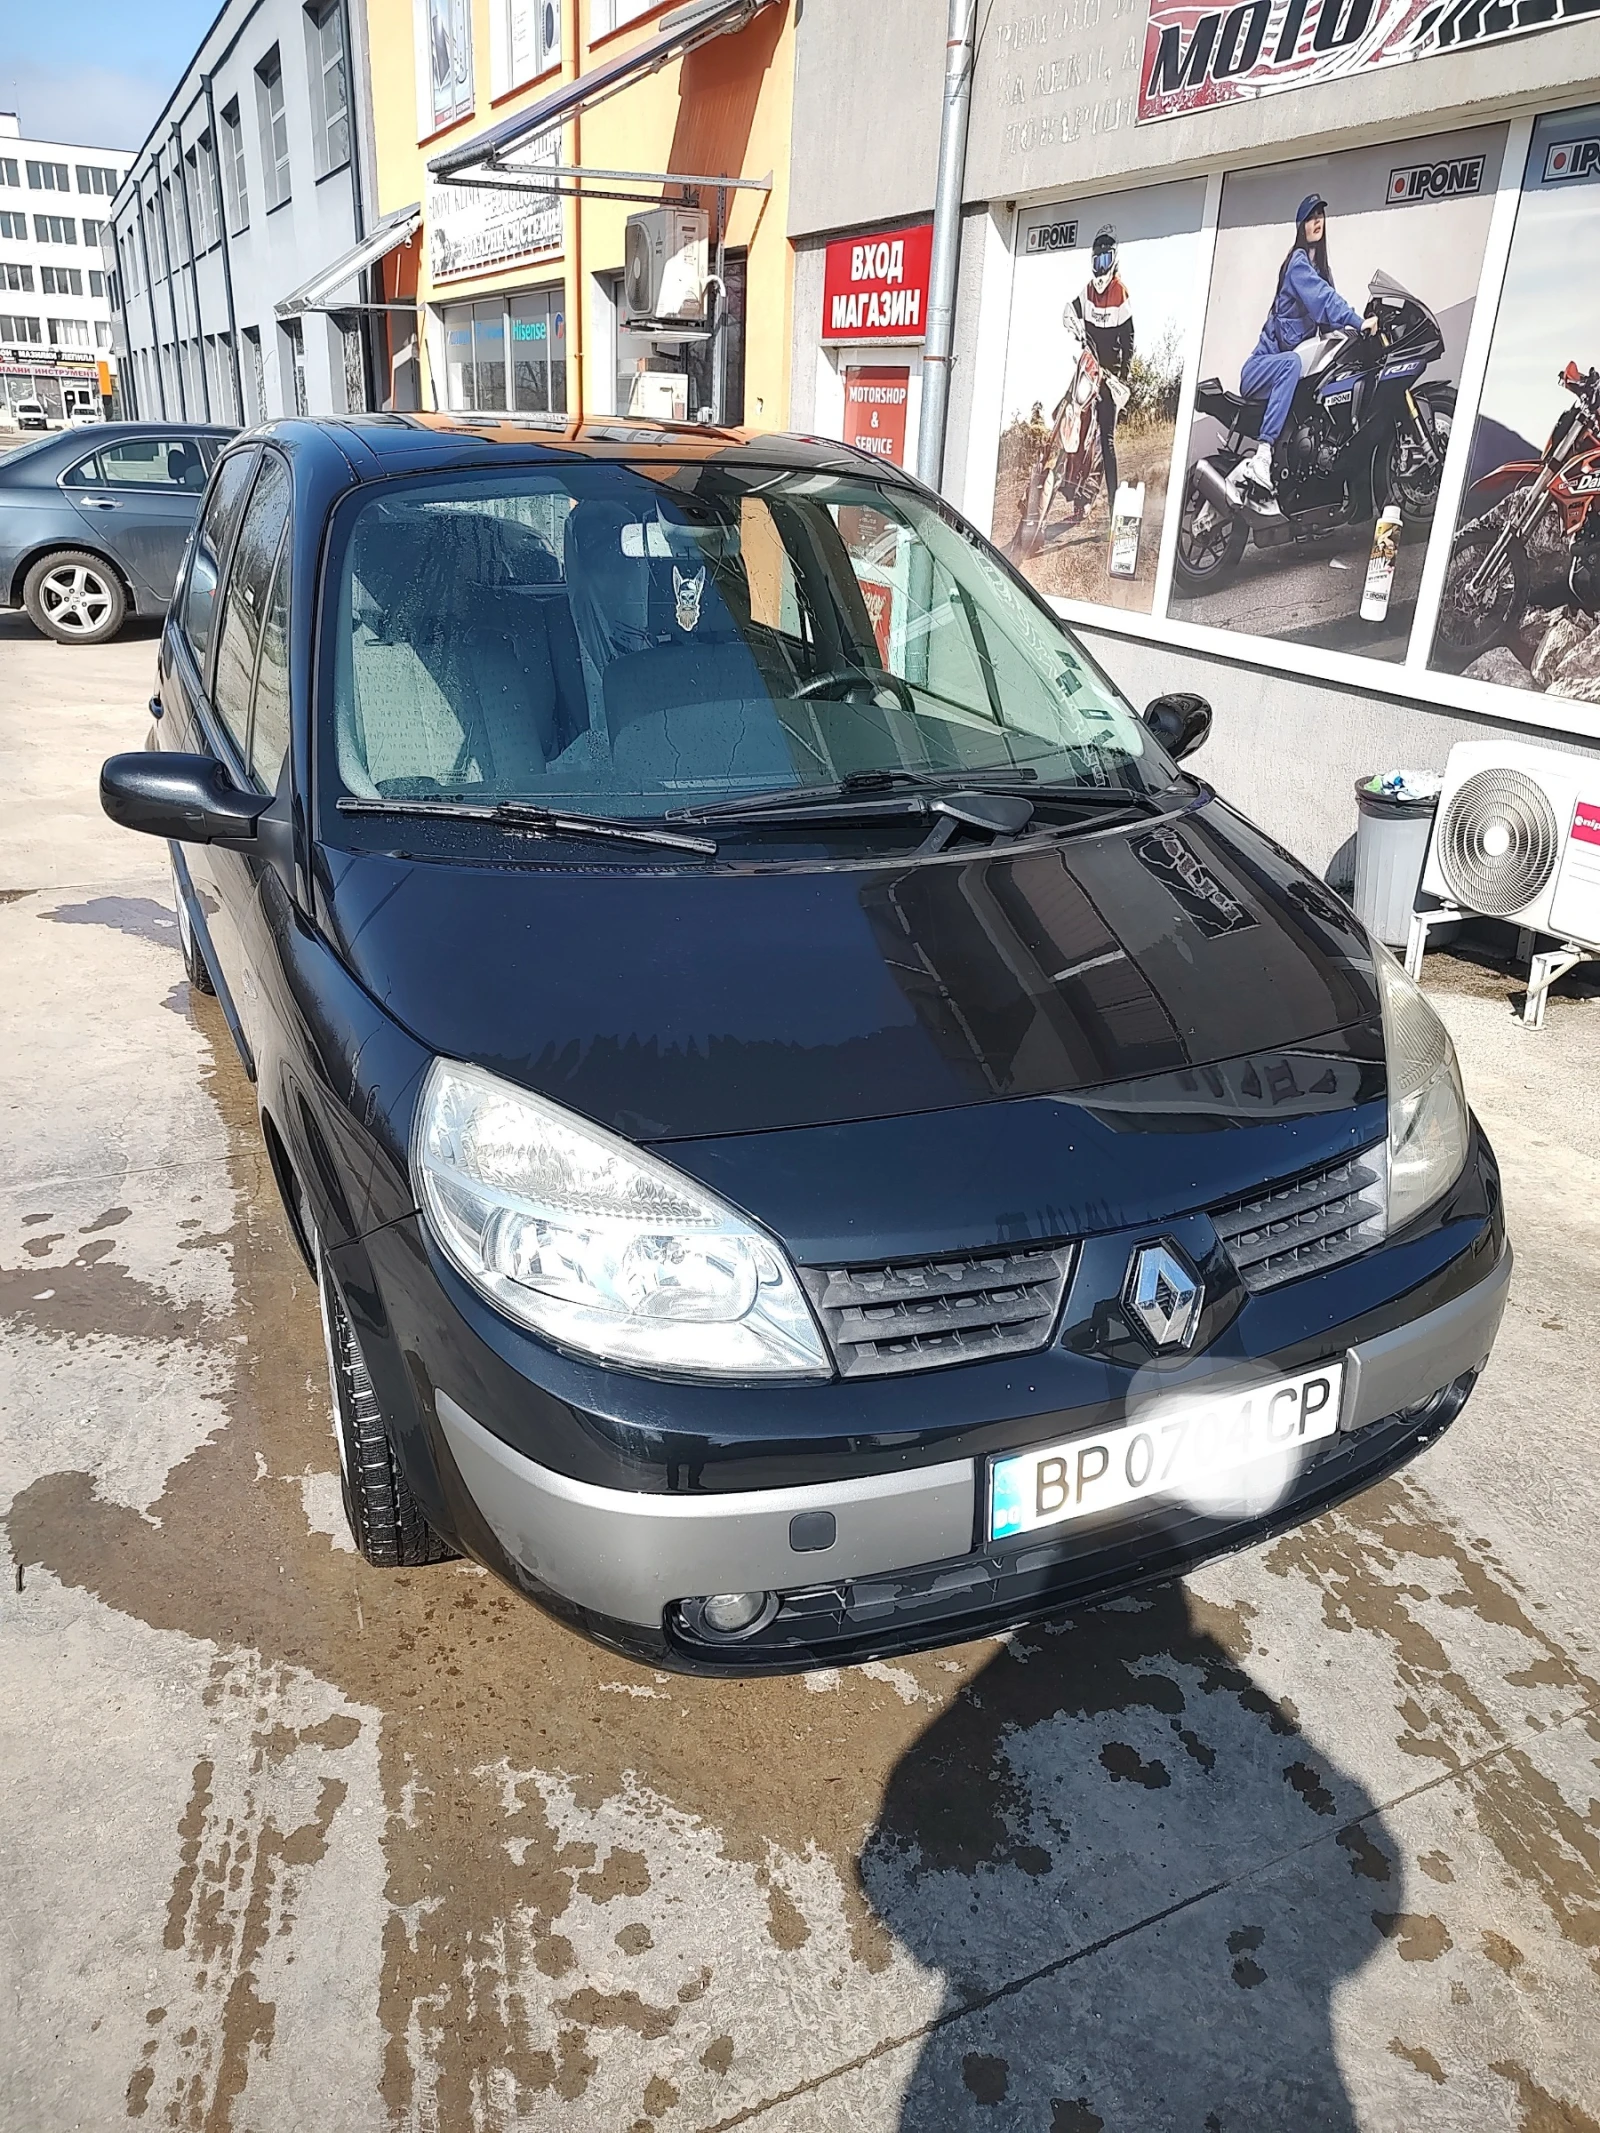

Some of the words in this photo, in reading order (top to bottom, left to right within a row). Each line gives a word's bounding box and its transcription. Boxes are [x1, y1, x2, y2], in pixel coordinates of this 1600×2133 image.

[1408, 161, 1481, 197] IPONE
[1038, 224, 1076, 249] IPONE
[851, 240, 904, 284] ВХОД
[831, 288, 920, 329] МАГАЗИН
[512, 319, 547, 340] Hisense
[849, 386, 906, 404] MOTORSHOP
[869, 411, 879, 429] &
[854, 435, 892, 455] SERVICE
[1036, 1445, 1110, 1517] BP
[1265, 1377, 1331, 1443] CP
